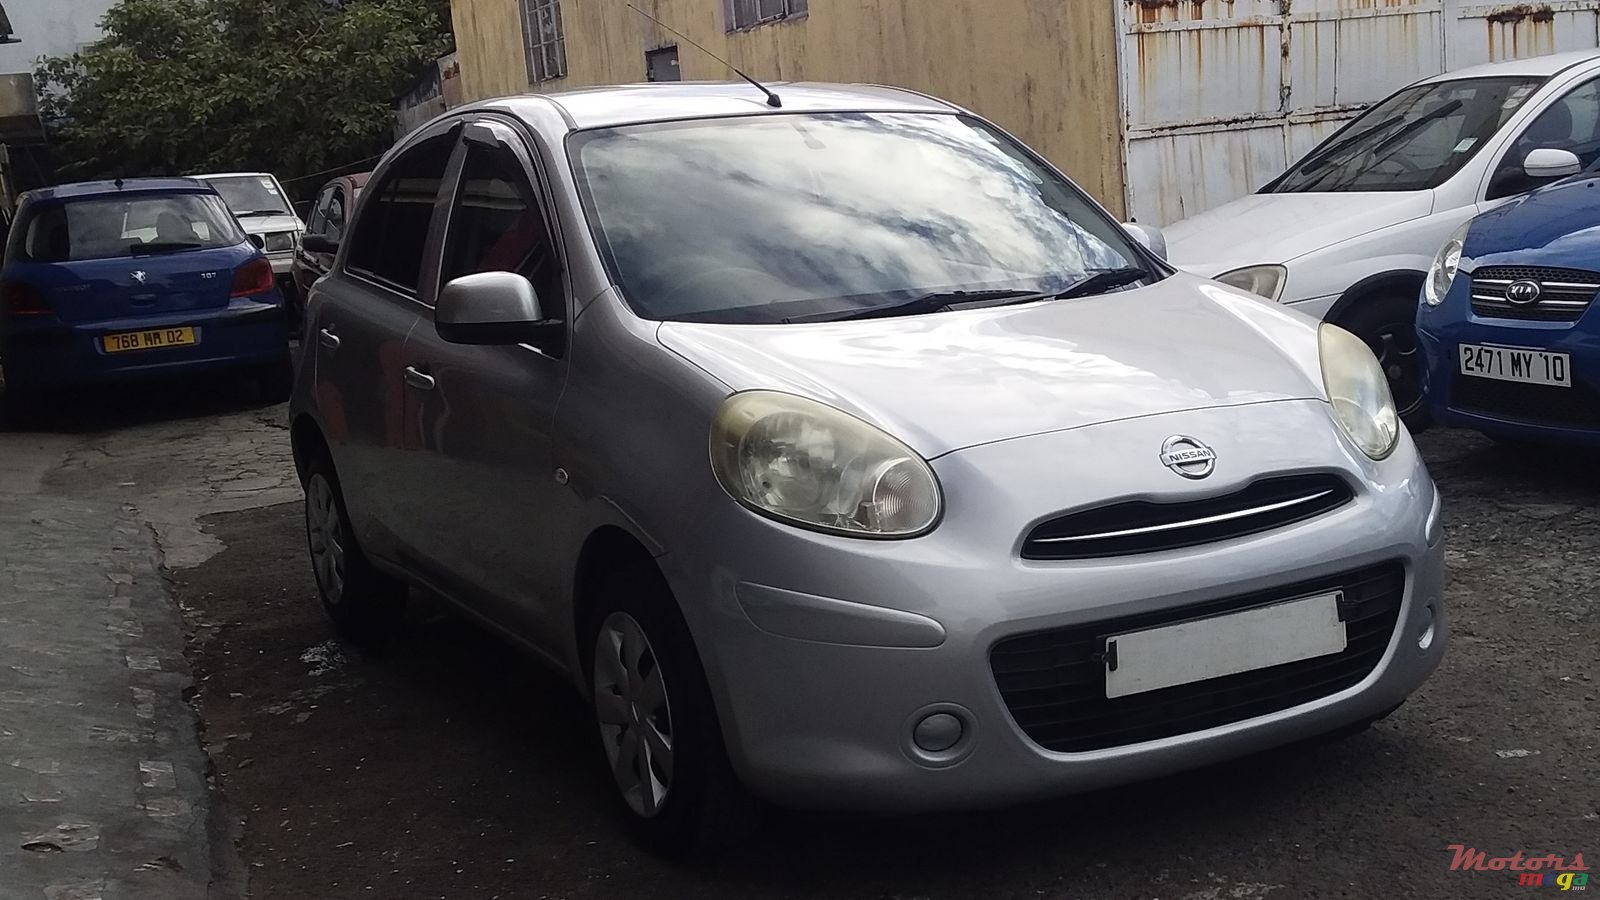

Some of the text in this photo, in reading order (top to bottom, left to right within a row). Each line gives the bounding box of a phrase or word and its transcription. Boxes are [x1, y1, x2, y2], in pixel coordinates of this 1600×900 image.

[1511, 285, 1532, 296] KIA
[112, 334, 139, 349] 768
[166, 329, 184, 343] 02
[1464, 346, 1503, 375] 2471
[1510, 351, 1533, 378] MY
[1169, 449, 1211, 462] NISSAN
